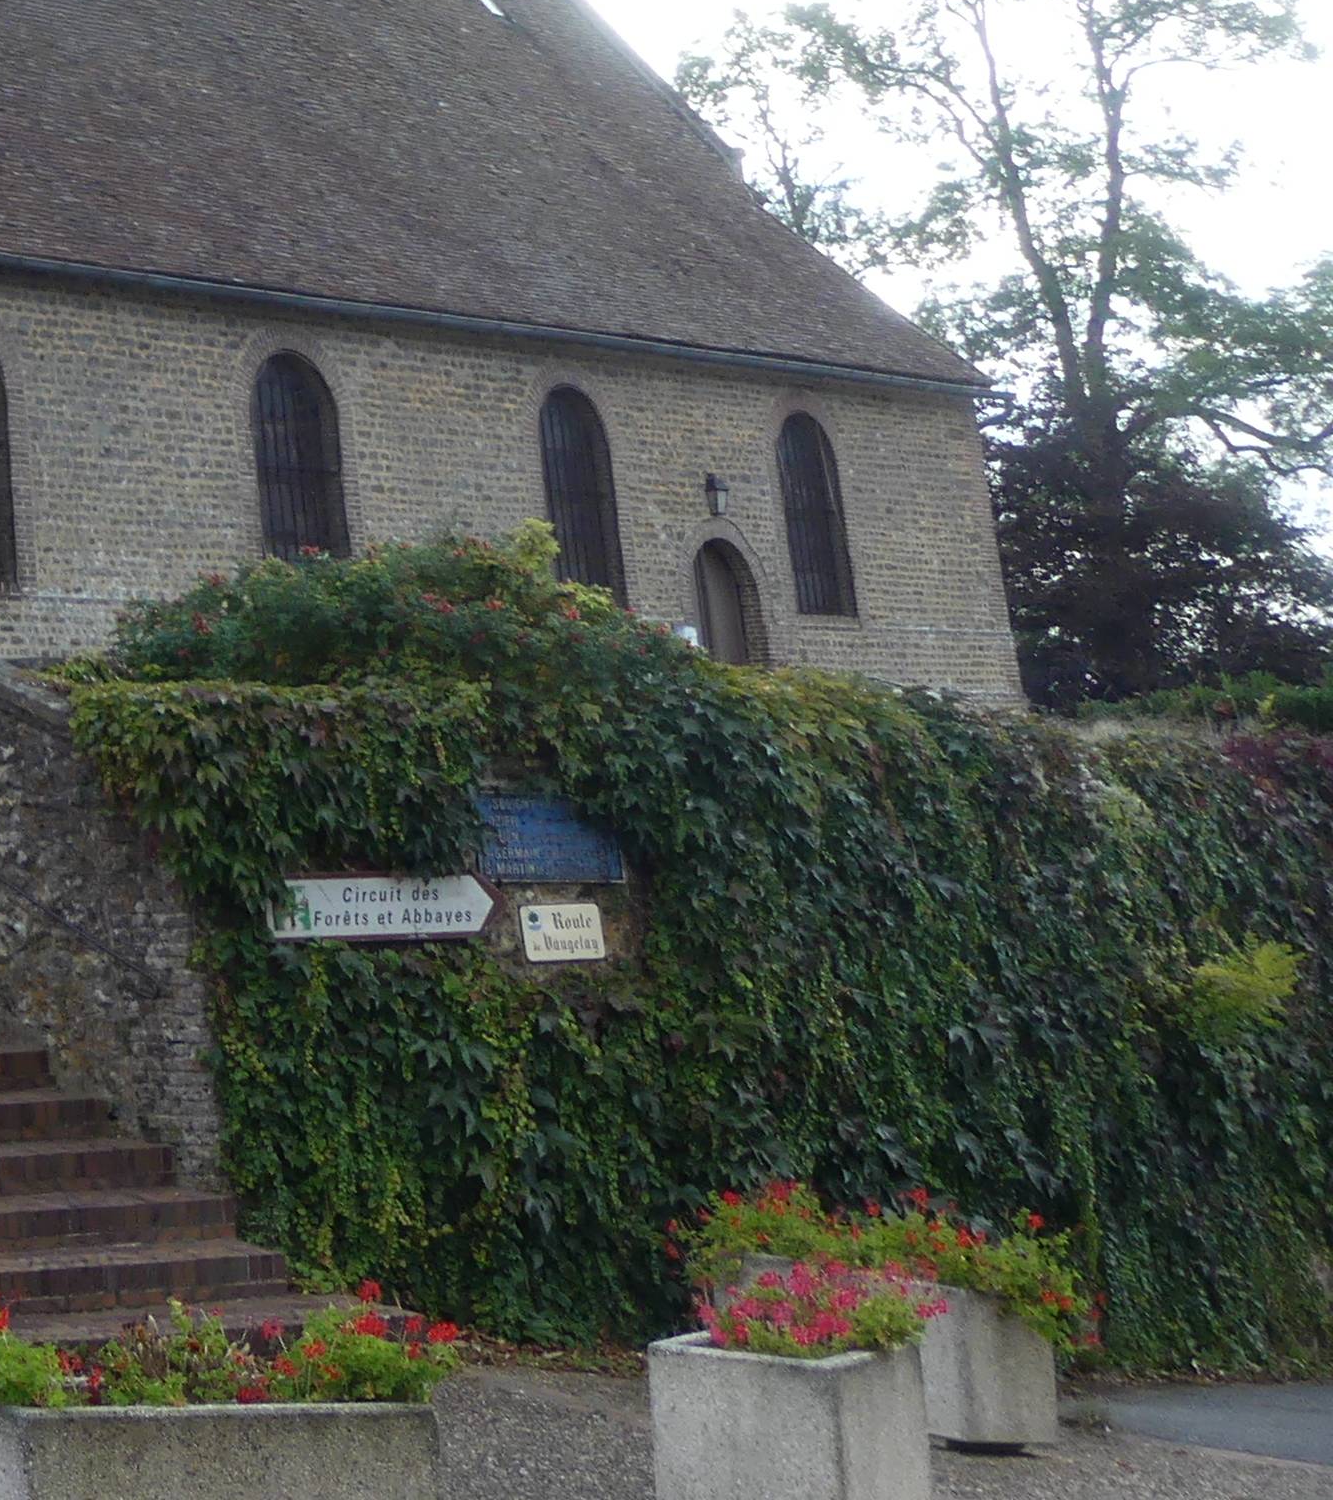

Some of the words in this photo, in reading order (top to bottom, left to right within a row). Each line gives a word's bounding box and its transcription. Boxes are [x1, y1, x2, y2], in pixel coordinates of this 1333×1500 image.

[342, 887, 402, 903] Circuit
[412, 886, 439, 901] des
[314, 910, 369, 927] Forêts
[377, 911, 393, 924] et
[401, 908, 472, 926] Abbayes
